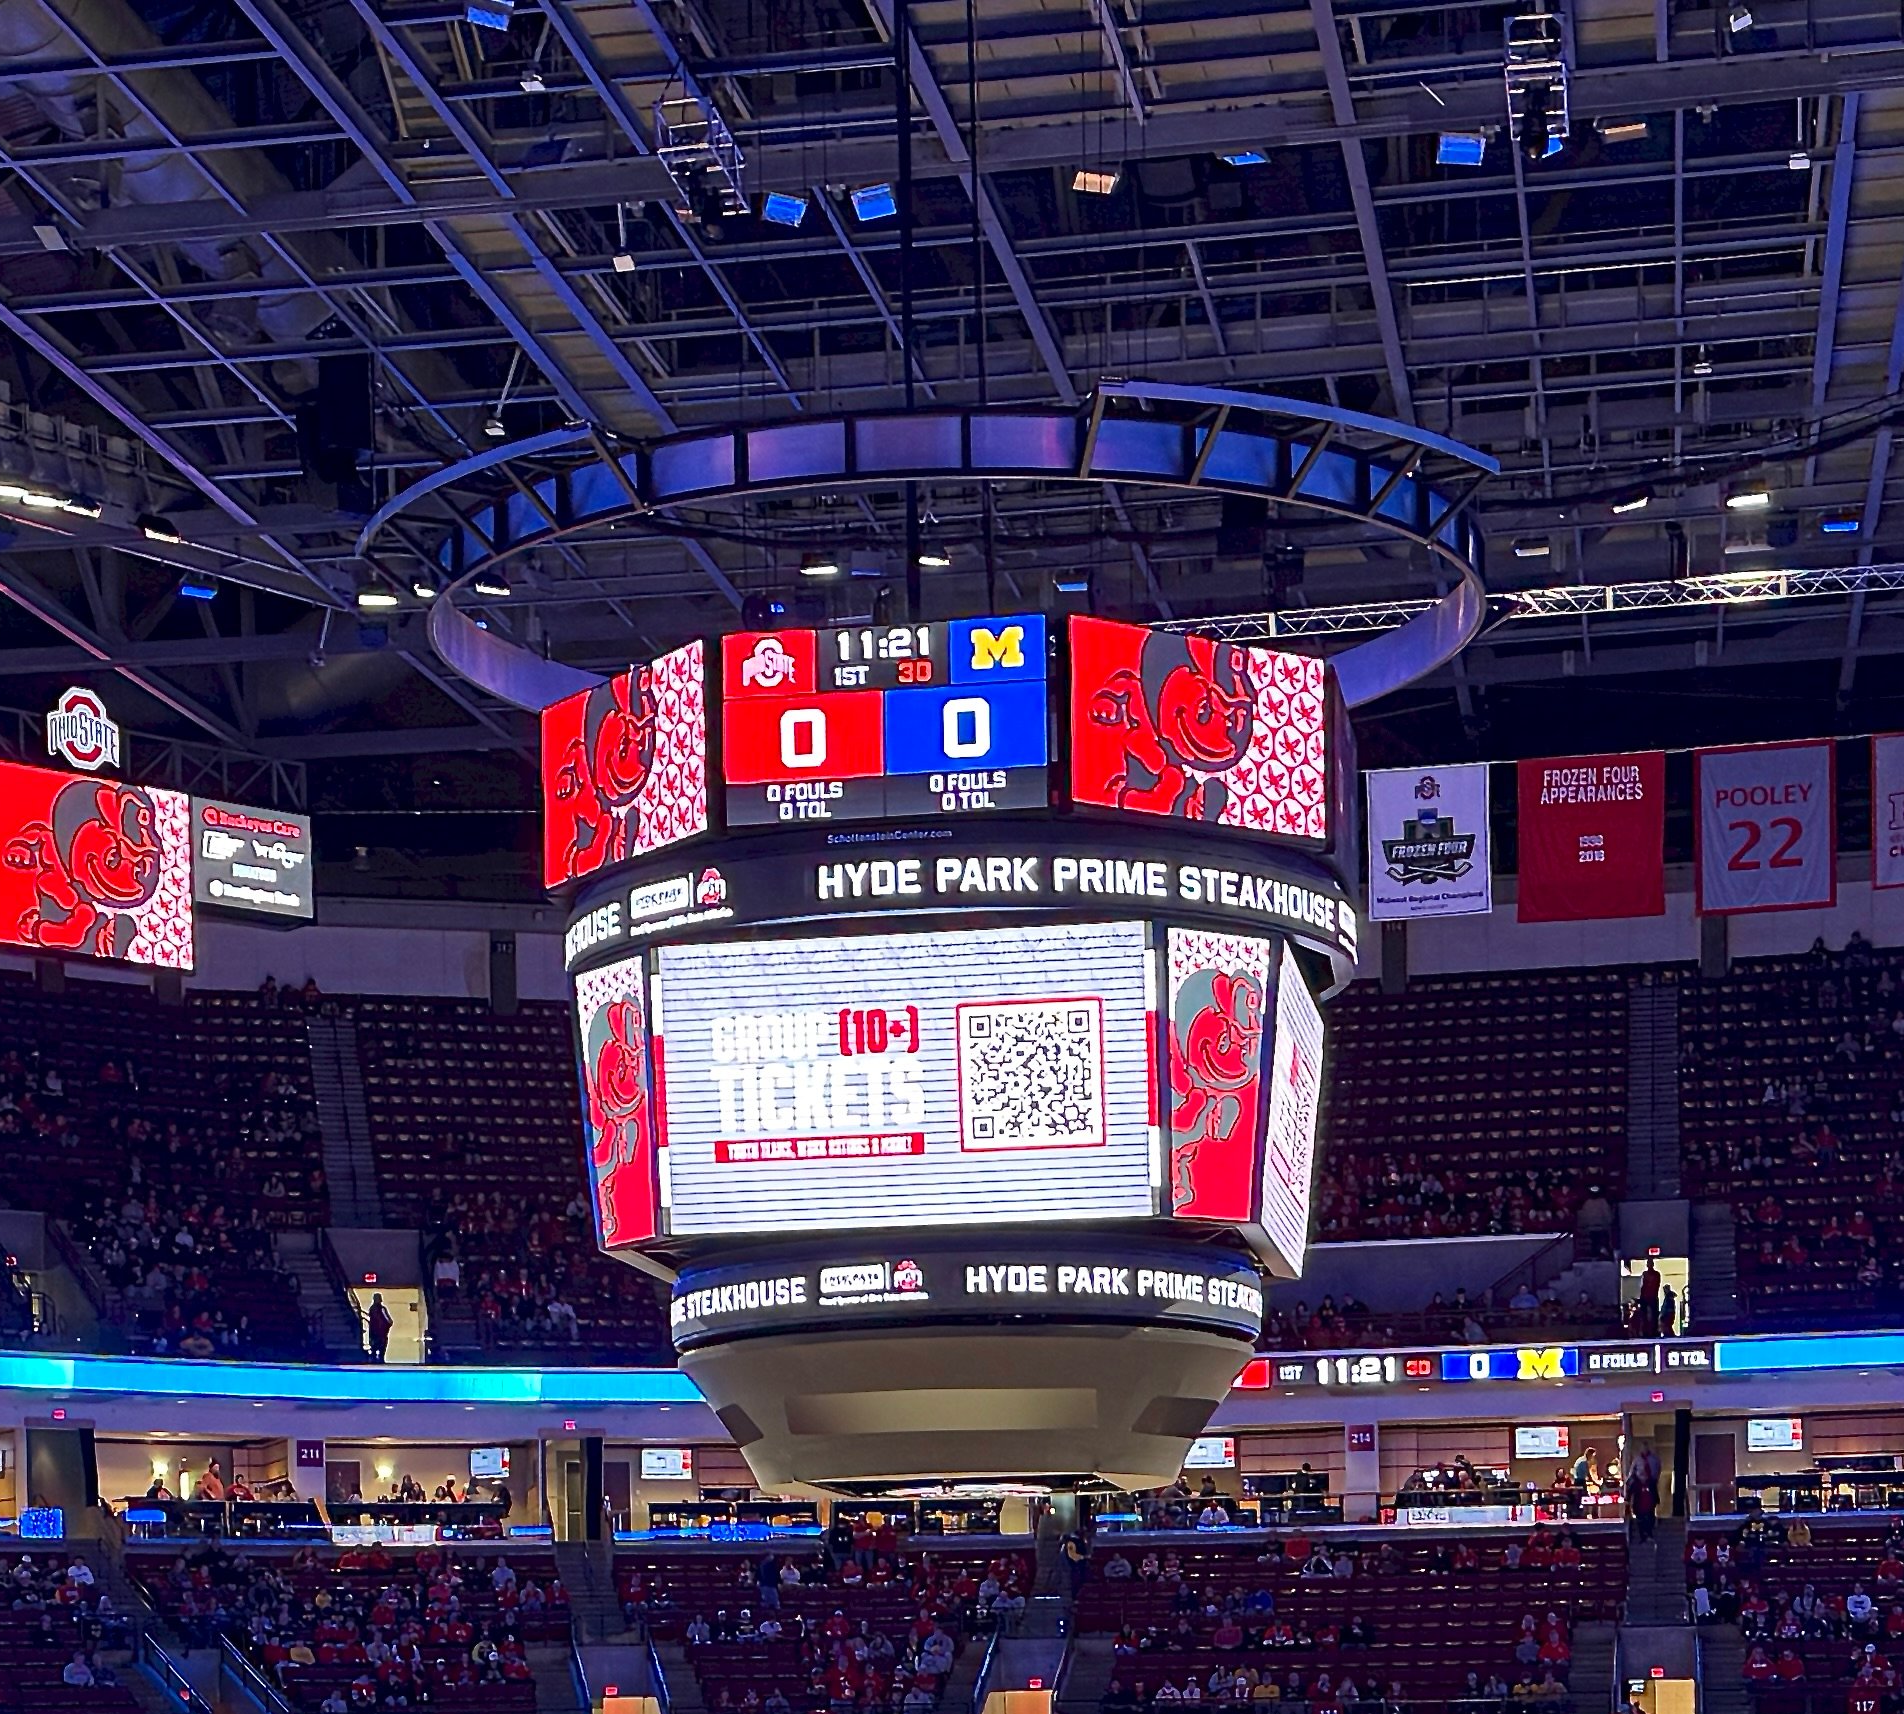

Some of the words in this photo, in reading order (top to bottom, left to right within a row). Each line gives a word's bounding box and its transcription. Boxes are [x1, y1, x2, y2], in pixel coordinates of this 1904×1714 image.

[838, 626, 930, 661] 11:21
[970, 625, 1025, 671] M
[834, 665, 870, 686] 1ST
[898, 659, 933, 684] 30
[780, 708, 827, 768] 0
[943, 697, 991, 758] 0
[930, 775, 944, 793] 0
[947, 771, 1007, 790] FOULS
[1543, 767, 1597, 787] FROZEN
[1603, 765, 1640, 784] FOUR
[767, 784, 781, 803] 0
[784, 781, 844, 801] FOULS
[941, 793, 956, 811] 0
[959, 791, 996, 809] TOL
[1540, 783, 1644, 805] APPEARANCES
[1715, 782, 1812, 809] POOLEY
[780, 803, 793, 820] 0
[795, 800, 833, 820] TOL
[273, 819, 301, 838] Care
[826, 828, 953, 845] SchottensteinCenter.com
[1391, 842, 1436, 859] FROZEN
[1727, 816, 1805, 871] 22
[817, 860, 922, 900] HYDE
[936, 856, 1040, 894] PARK
[1053, 857, 1169, 897] PRIME
[1179, 866, 1336, 932] STEAKHOUSE
[710, 1057, 927, 1133] TICKETS
[965, 1265, 1048, 1294] HYDE
[1057, 1266, 1130, 1296] PARK
[1137, 1269, 1205, 1303] PRIME
[687, 1276, 807, 1323] STEAKHOUSE
[1279, 1364, 1304, 1380] 1ST
[1315, 1356, 1396, 1385] 11:21
[1469, 1352, 1491, 1379] 0
[1517, 1348, 1566, 1381] M
[1601, 1352, 1649, 1369] FOULS
[1682, 1349, 1710, 1365] TOL
[301, 1448, 320, 1459] 211
[1856, 1701, 1876, 1711] 117
